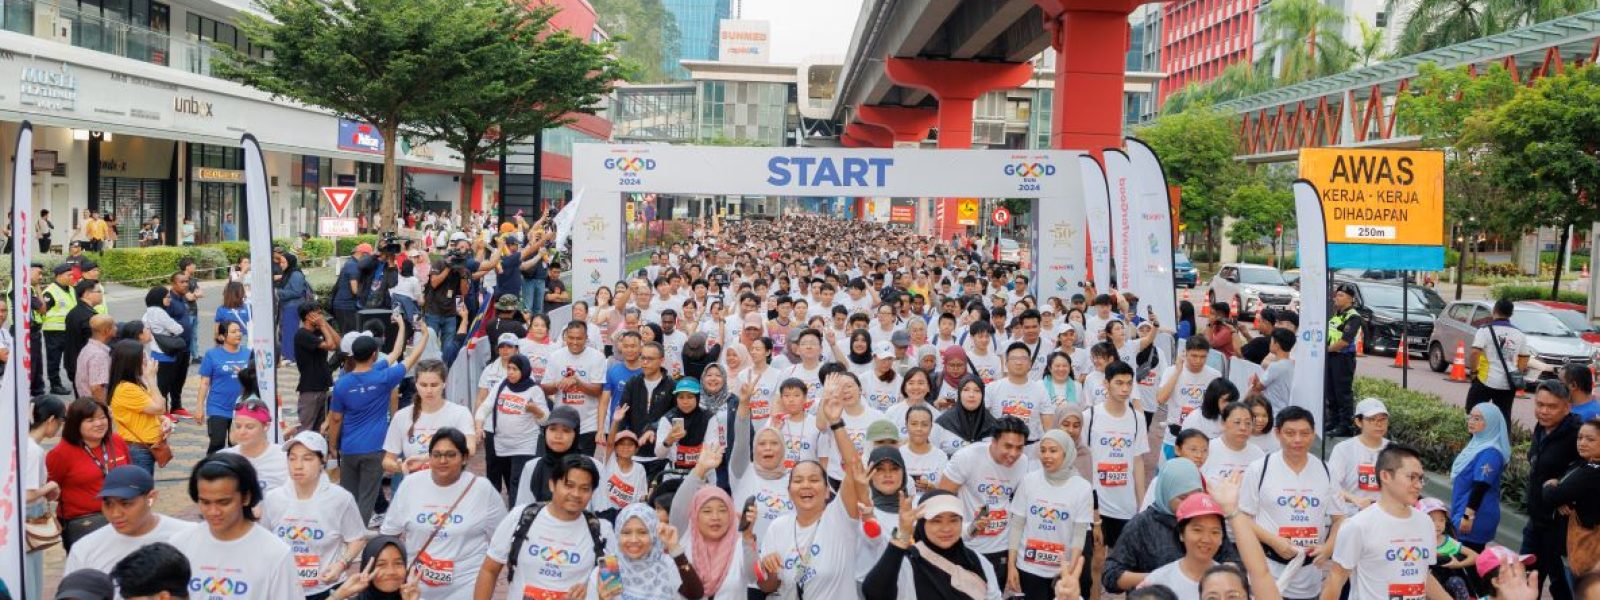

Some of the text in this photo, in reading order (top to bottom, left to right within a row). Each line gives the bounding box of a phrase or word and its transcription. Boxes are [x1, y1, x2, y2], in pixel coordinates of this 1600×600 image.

[604, 157, 656, 172] GOOD
[767, 156, 894, 187] START
[1004, 162, 1056, 177] GOOD
[1330, 155, 1415, 186] AWAS
[619, 178, 641, 186] 2024
[1323, 189, 1365, 203] KERJA
[1377, 190, 1420, 204] KERJA
[1333, 207, 1409, 221] DIHADAPAN
[1357, 227, 1385, 237] 250m
[1277, 496, 1320, 509] GOOD
[1030, 505, 1070, 520] GOOD
[1290, 514, 1310, 522] 2024
[278, 526, 324, 540] GOOD
[528, 544, 581, 564] GOOD
[1037, 552, 1062, 562] 9387
[1386, 546, 1430, 561] GOOD
[539, 568, 562, 578] 2024
[1401, 568, 1418, 577] 2024
[189, 576, 248, 595] GOOD
